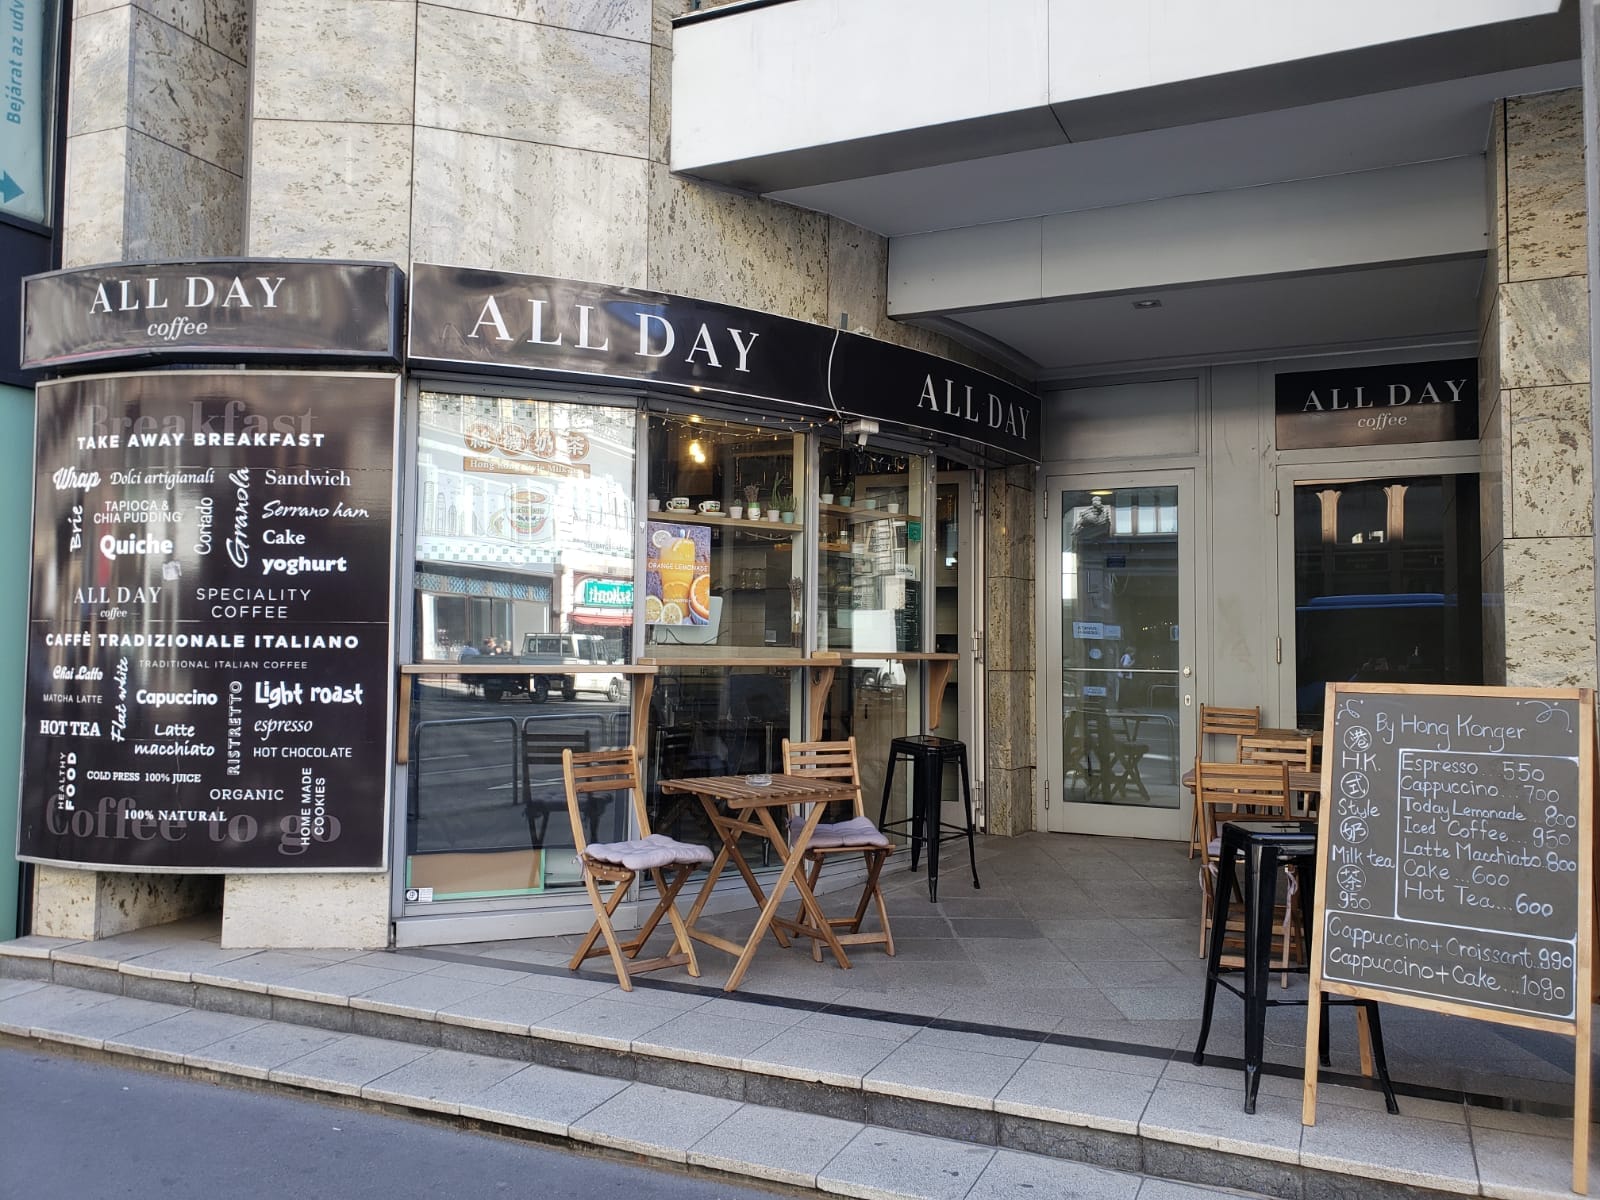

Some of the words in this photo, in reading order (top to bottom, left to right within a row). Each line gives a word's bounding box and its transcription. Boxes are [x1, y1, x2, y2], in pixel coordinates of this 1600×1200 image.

[12, 36, 23, 56] az
[5, 60, 25, 124] Bejárat
[89, 278, 169, 314] ALL
[185, 276, 286, 309] DAY
[147, 316, 208, 340] coffee
[468, 295, 609, 351] ALL
[634, 312, 760, 373] DAY
[916, 373, 979, 424] ALL
[987, 392, 1031, 441] DAY
[1303, 386, 1374, 412] ALL
[1387, 379, 1467, 407] DAY
[86, 400, 318, 442] Breakfast
[1358, 412, 1408, 431] coffee
[77, 435, 119, 450] TAKE
[127, 433, 184, 448] AWAY
[193, 433, 325, 448] BREAKFAST
[52, 466, 101, 493] Wrap
[110, 468, 141, 486] Dolci
[144, 467, 215, 490] artigianali
[265, 469, 352, 487] Sandwich
[93, 511, 121, 524] CHIA
[123, 511, 183, 523] PUDDING
[105, 500, 157, 512] TAPIOCA
[157, 500, 169, 512] &
[226, 467, 249, 568] Granola
[262, 499, 330, 519] Serrano
[332, 502, 370, 518] ham
[68, 504, 83, 552] Brie
[194, 497, 213, 555] Cortado
[262, 529, 306, 545] Cake
[100, 533, 174, 560] Quiche
[262, 556, 348, 576] yoghurt
[74, 586, 110, 604] ALL
[117, 586, 161, 604] DAY
[196, 587, 312, 601] SPECIALITY
[100, 607, 128, 620] coffee
[211, 605, 289, 619] COFFEE
[45, 631, 92, 647] CAFFÈ
[98, 633, 245, 648] TRADIZIONALE
[254, 634, 359, 649] ITALIANO
[138, 659, 210, 669] TRADITIONAL
[214, 660, 258, 669] ITALIAN
[263, 660, 308, 669] COFFEE
[113, 656, 128, 700] white
[43, 693, 73, 704] MATCHA
[77, 694, 103, 704] LATTE
[136, 689, 218, 708] Capuccino
[255, 680, 303, 709] Light
[310, 682, 364, 706] roast
[40, 720, 68, 735] HOT
[70, 721, 101, 737] TEA
[111, 703, 128, 743] Flat
[154, 724, 196, 738] Latte
[227, 680, 243, 776] RISTRETTO
[254, 718, 313, 741] espresso
[1376, 711, 1394, 744] By
[1401, 714, 1450, 750] Hong
[1457, 713, 1527, 752] Konger
[134, 740, 215, 757] macchiato
[253, 747, 278, 758] HOT
[281, 747, 352, 758] CHOCOLATE
[87, 770, 111, 781] COLD
[113, 772, 140, 782] PRESS
[145, 773, 170, 783] 100%
[171, 773, 202, 785] JUICE
[1402, 752, 1478, 778] Espresso
[1502, 761, 1544, 782] 550
[58, 752, 66, 810] HEALTHY
[65, 752, 77, 811] FOOD
[301, 767, 312, 804] MADE
[1400, 775, 1499, 799] Cappuccino
[1523, 785, 1559, 804] 700
[209, 788, 284, 801] ORGANIC
[314, 777, 326, 836] COOKIES
[124, 810, 154, 821] 100%
[158, 810, 228, 823] NATURAL
[1338, 798, 1381, 819] Style
[1403, 796, 1449, 822] Today
[1452, 800, 1527, 821] Lemonade
[1544, 805, 1576, 828] 800
[46, 794, 187, 842] Coffee
[208, 806, 258, 842] to
[278, 814, 341, 855] go
[300, 807, 312, 846] HOME
[1404, 816, 1436, 835] Iced
[1447, 819, 1509, 843] Coffee
[1532, 827, 1570, 848] 950
[1332, 844, 1364, 864] Milk
[1366, 849, 1396, 869] tea
[1404, 838, 1451, 859] Latte
[1456, 843, 1542, 868] Macchiato
[1546, 851, 1576, 872] 800
[1403, 859, 1450, 880] Cake
[1472, 865, 1510, 886] 600
[1338, 891, 1372, 910] 950
[1404, 880, 1445, 902] Hot
[1454, 885, 1494, 909] Tea
[1515, 893, 1553, 917] 600
[1446, 938, 1534, 968] Croissant
[1452, 965, 1500, 991] Cake
